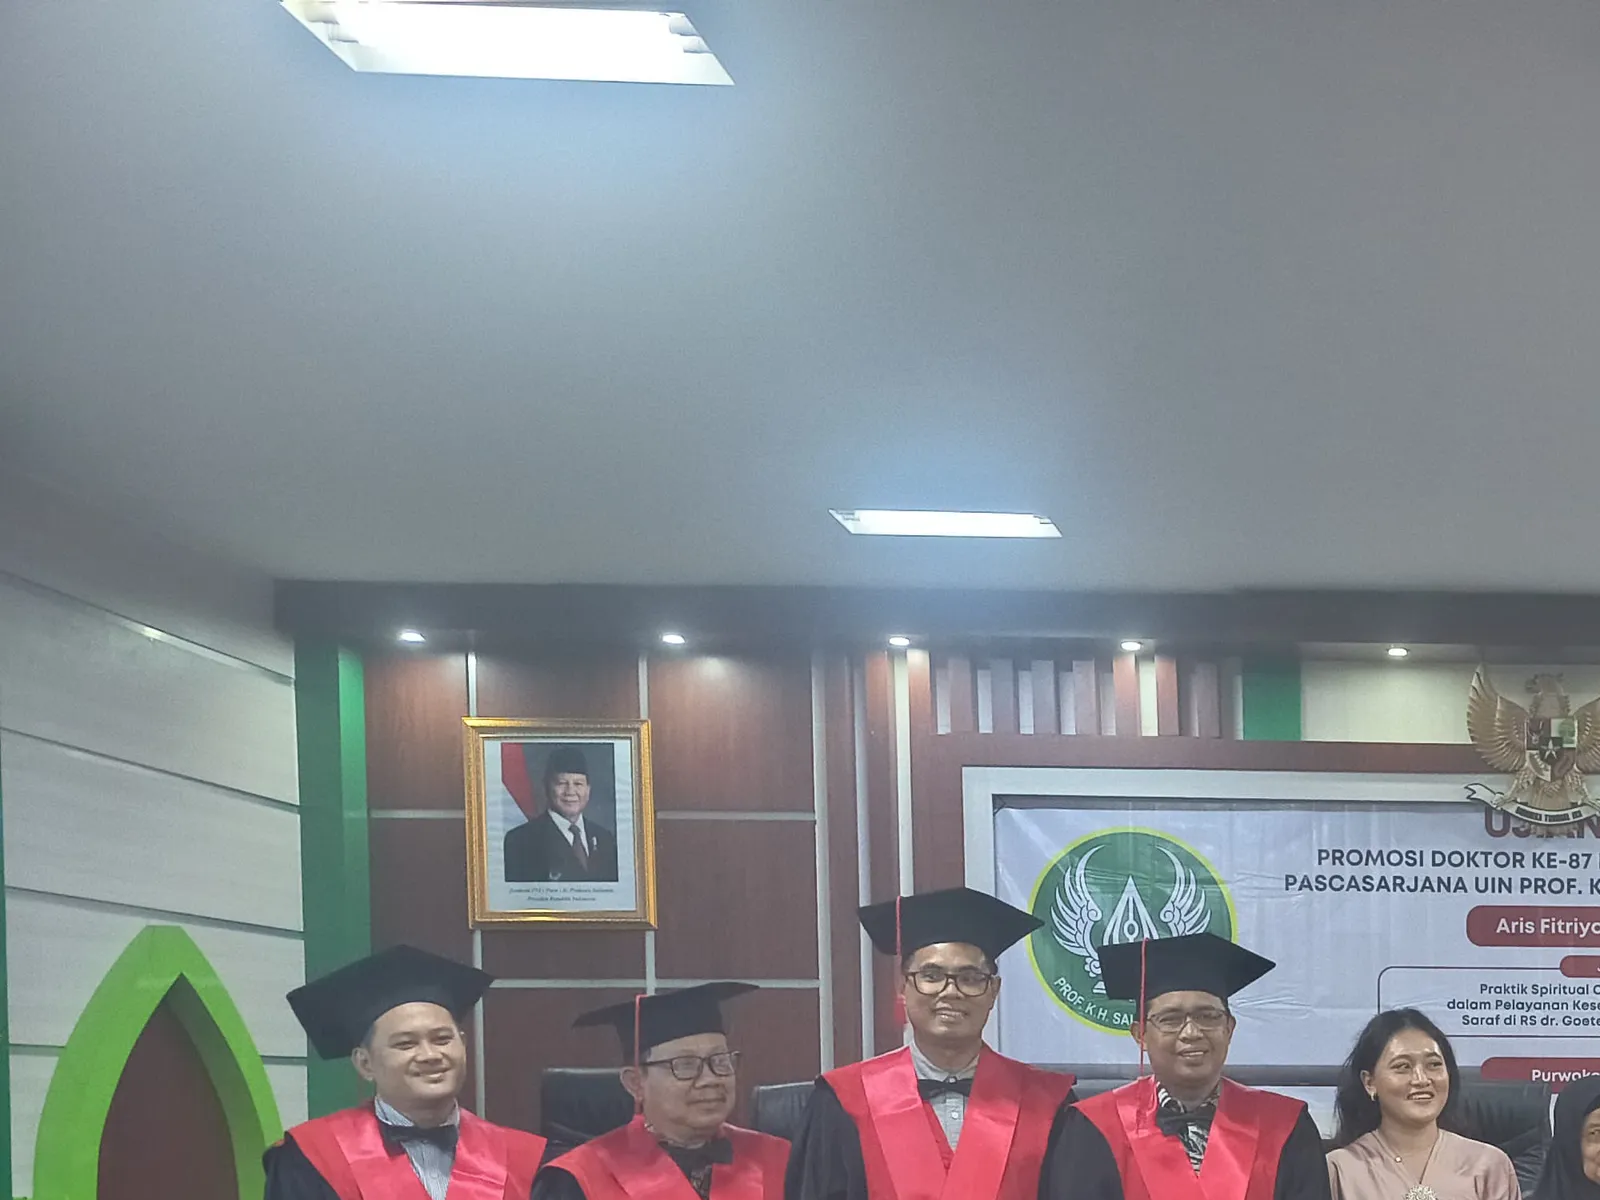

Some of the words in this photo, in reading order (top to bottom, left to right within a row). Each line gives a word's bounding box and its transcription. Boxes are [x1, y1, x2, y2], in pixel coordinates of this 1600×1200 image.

[1317, 848, 1424, 867] PROMOSI
[1431, 850, 1525, 869] DOKTOR
[1532, 851, 1593, 870] KE-87
[1284, 874, 1468, 894] PASCASARJANA
[1474, 876, 1513, 894] UIN
[1519, 877, 1583, 895] PROF.
[1496, 917, 1535, 934] Aris
[1053, 976, 1085, 1010] PROF.
[1480, 983, 1528, 995] Praktik
[1531, 983, 1589, 997] Spiritual
[1446, 998, 1491, 1010] dalam
[1495, 999, 1569, 1014] Pelayanan
[1461, 1014, 1501, 1026] Saraf
[1503, 1014, 1517, 1026] di
[1520, 1014, 1537, 1026] RS
[1540, 1015, 1559, 1026] dr.
